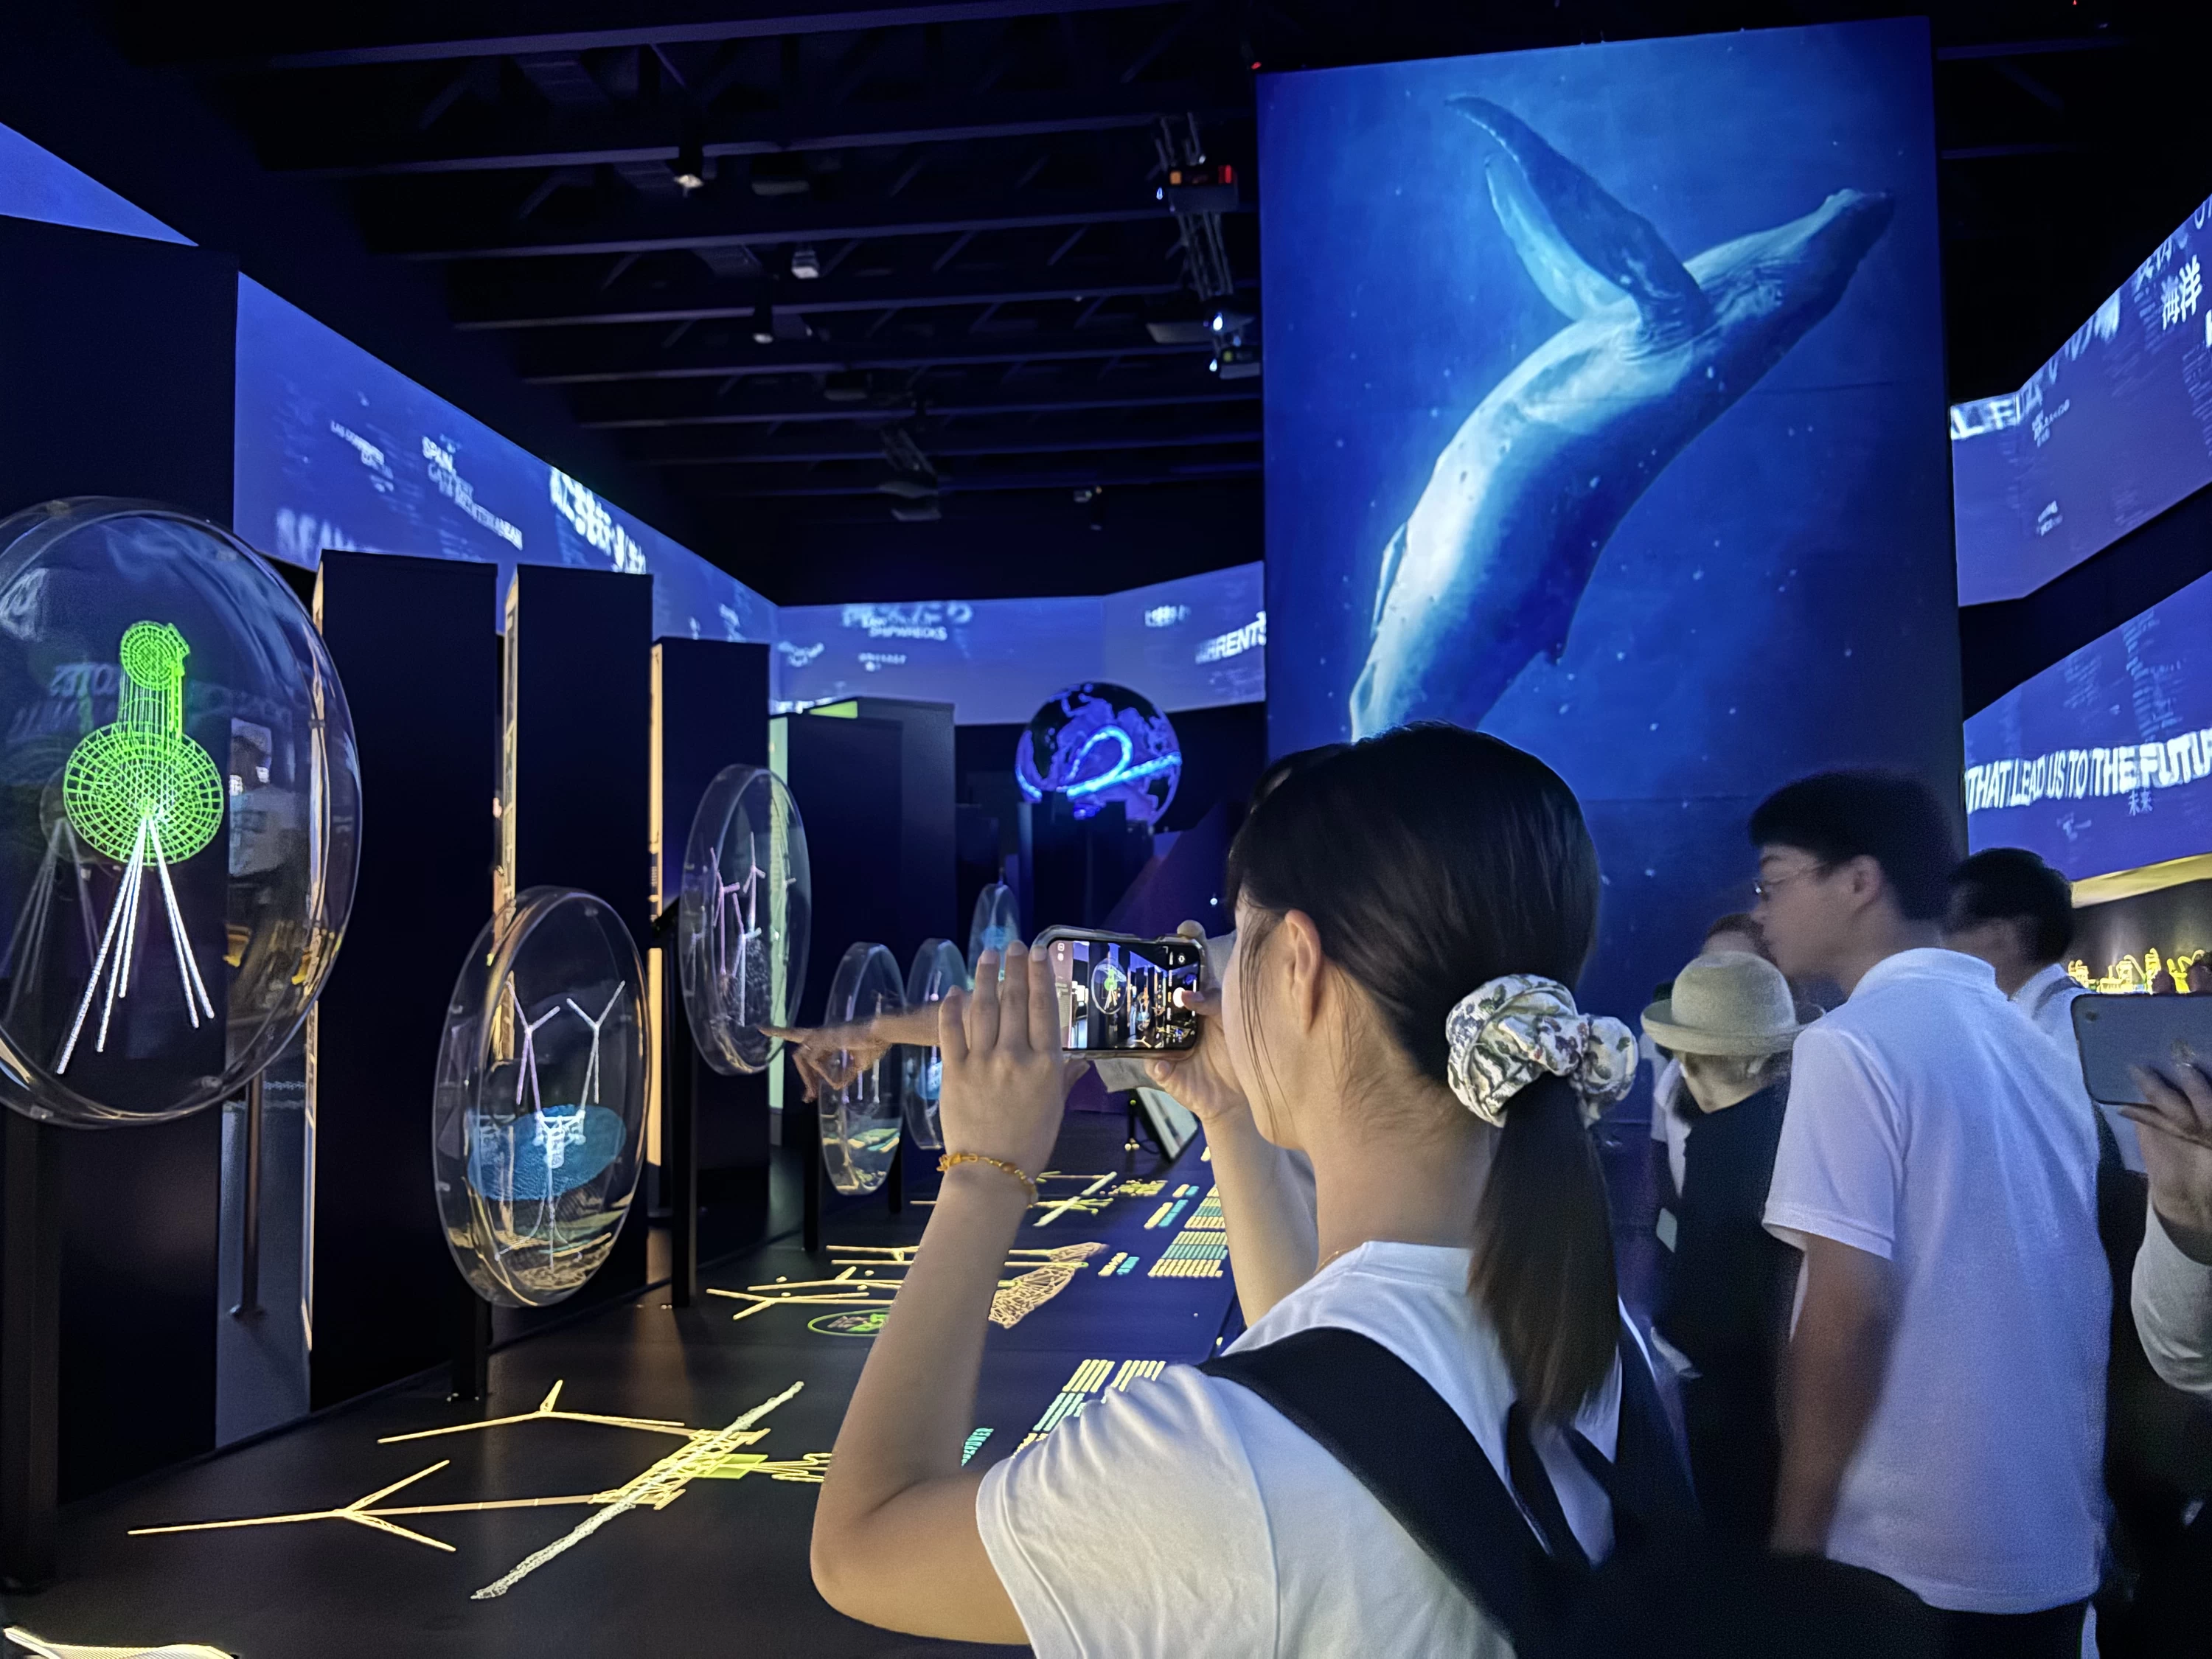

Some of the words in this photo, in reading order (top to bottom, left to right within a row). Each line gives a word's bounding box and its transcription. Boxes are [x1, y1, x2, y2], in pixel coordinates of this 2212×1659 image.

[2161, 254, 2202, 330] 海洋
[1966, 760, 2011, 815] THAT
[2010, 754, 2045, 807] LEAD
[2044, 749, 2065, 800] US
[2065, 748, 2090, 799] TO
[2091, 745, 2138, 797] THE
